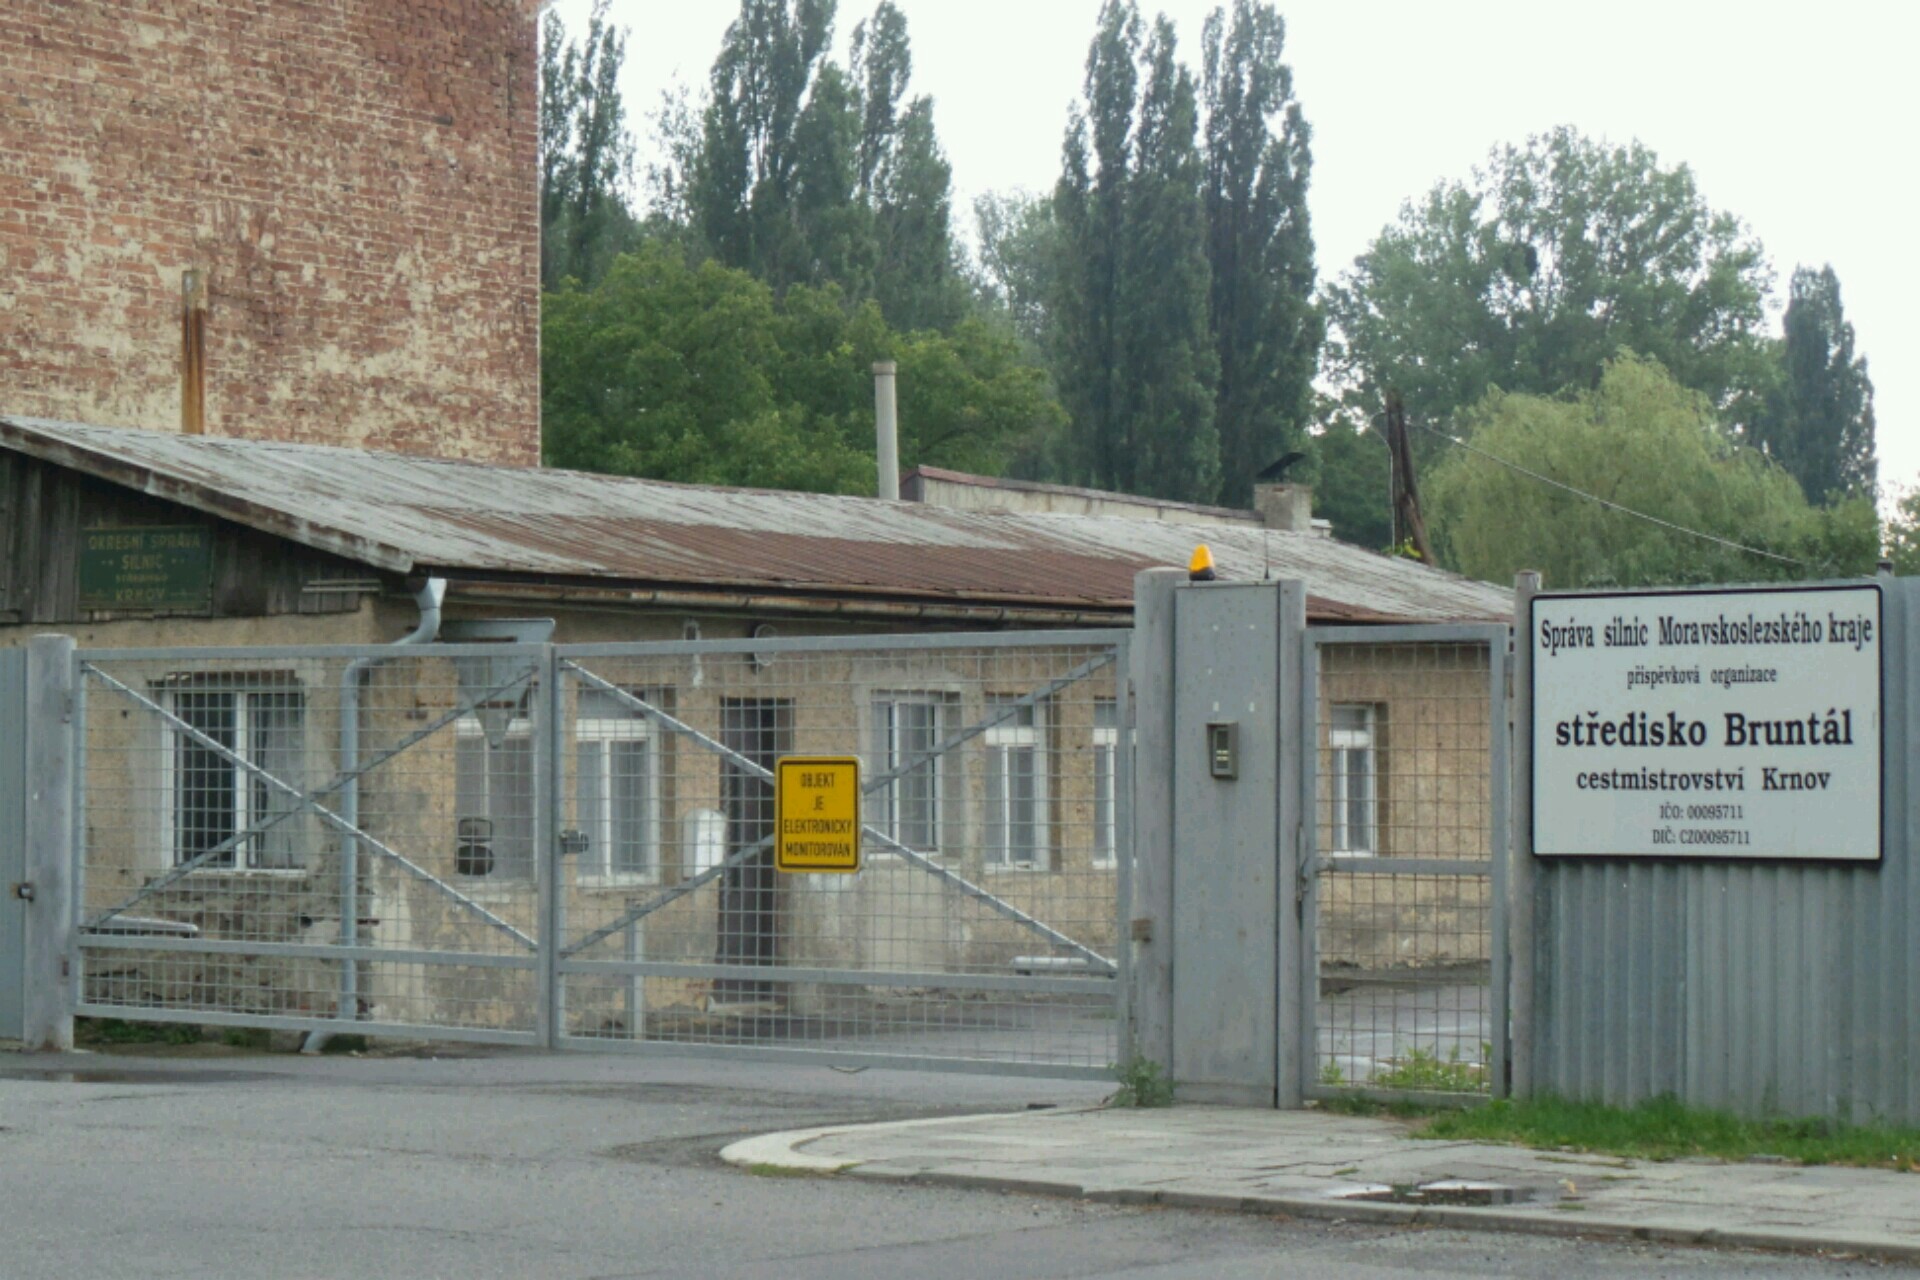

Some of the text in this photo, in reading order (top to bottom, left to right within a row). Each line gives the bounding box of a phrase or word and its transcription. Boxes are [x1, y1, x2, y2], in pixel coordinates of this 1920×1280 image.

[121, 553, 165, 570] SILNIC
[115, 588, 166, 602] KRNOV
[1541, 610, 1873, 656] Správa silnic Moravskoslezského kraje
[1627, 664, 1778, 690] příspěvková organizace
[1556, 708, 1854, 746] středisko Bruntál
[801, 773, 835, 787] OBJEKT
[1577, 766, 1832, 791] cestmistrovství Krnov
[814, 796, 824, 810] JE
[1659, 802, 1743, 820] IČO: 00095711
[784, 819, 852, 834] ELEKTRONICKY
[1652, 826, 1676, 845] DIČ:
[785, 838, 851, 857] MONITOROVÁN
